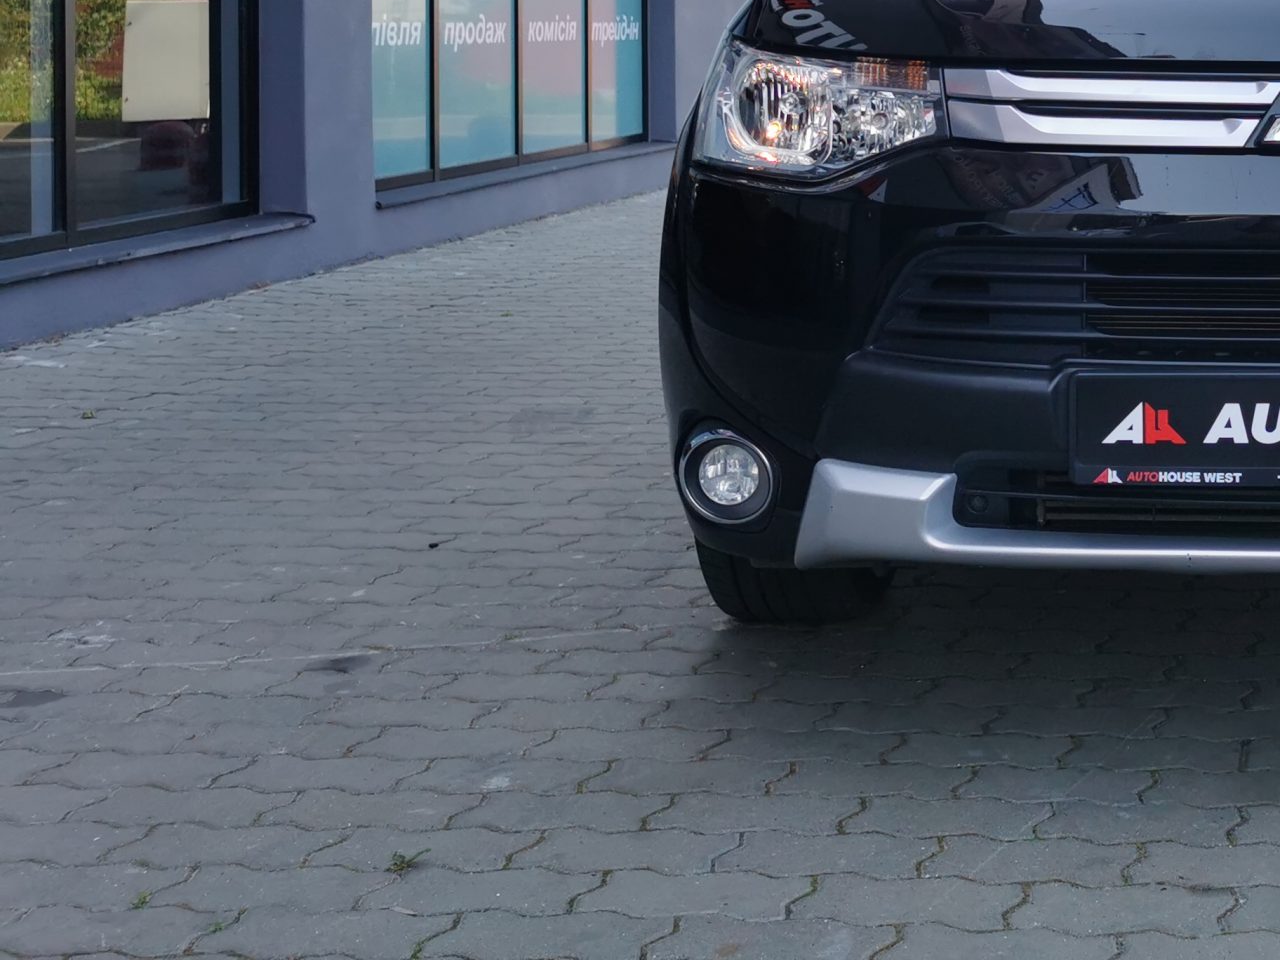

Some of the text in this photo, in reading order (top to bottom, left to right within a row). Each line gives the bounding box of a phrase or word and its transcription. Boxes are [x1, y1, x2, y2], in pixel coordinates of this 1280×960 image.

[444, 14, 507, 52] продаж
[528, 14, 577, 43] комісія
[592, 14, 639, 48] трейд-ін
[1203, 472, 1243, 483] WEST
